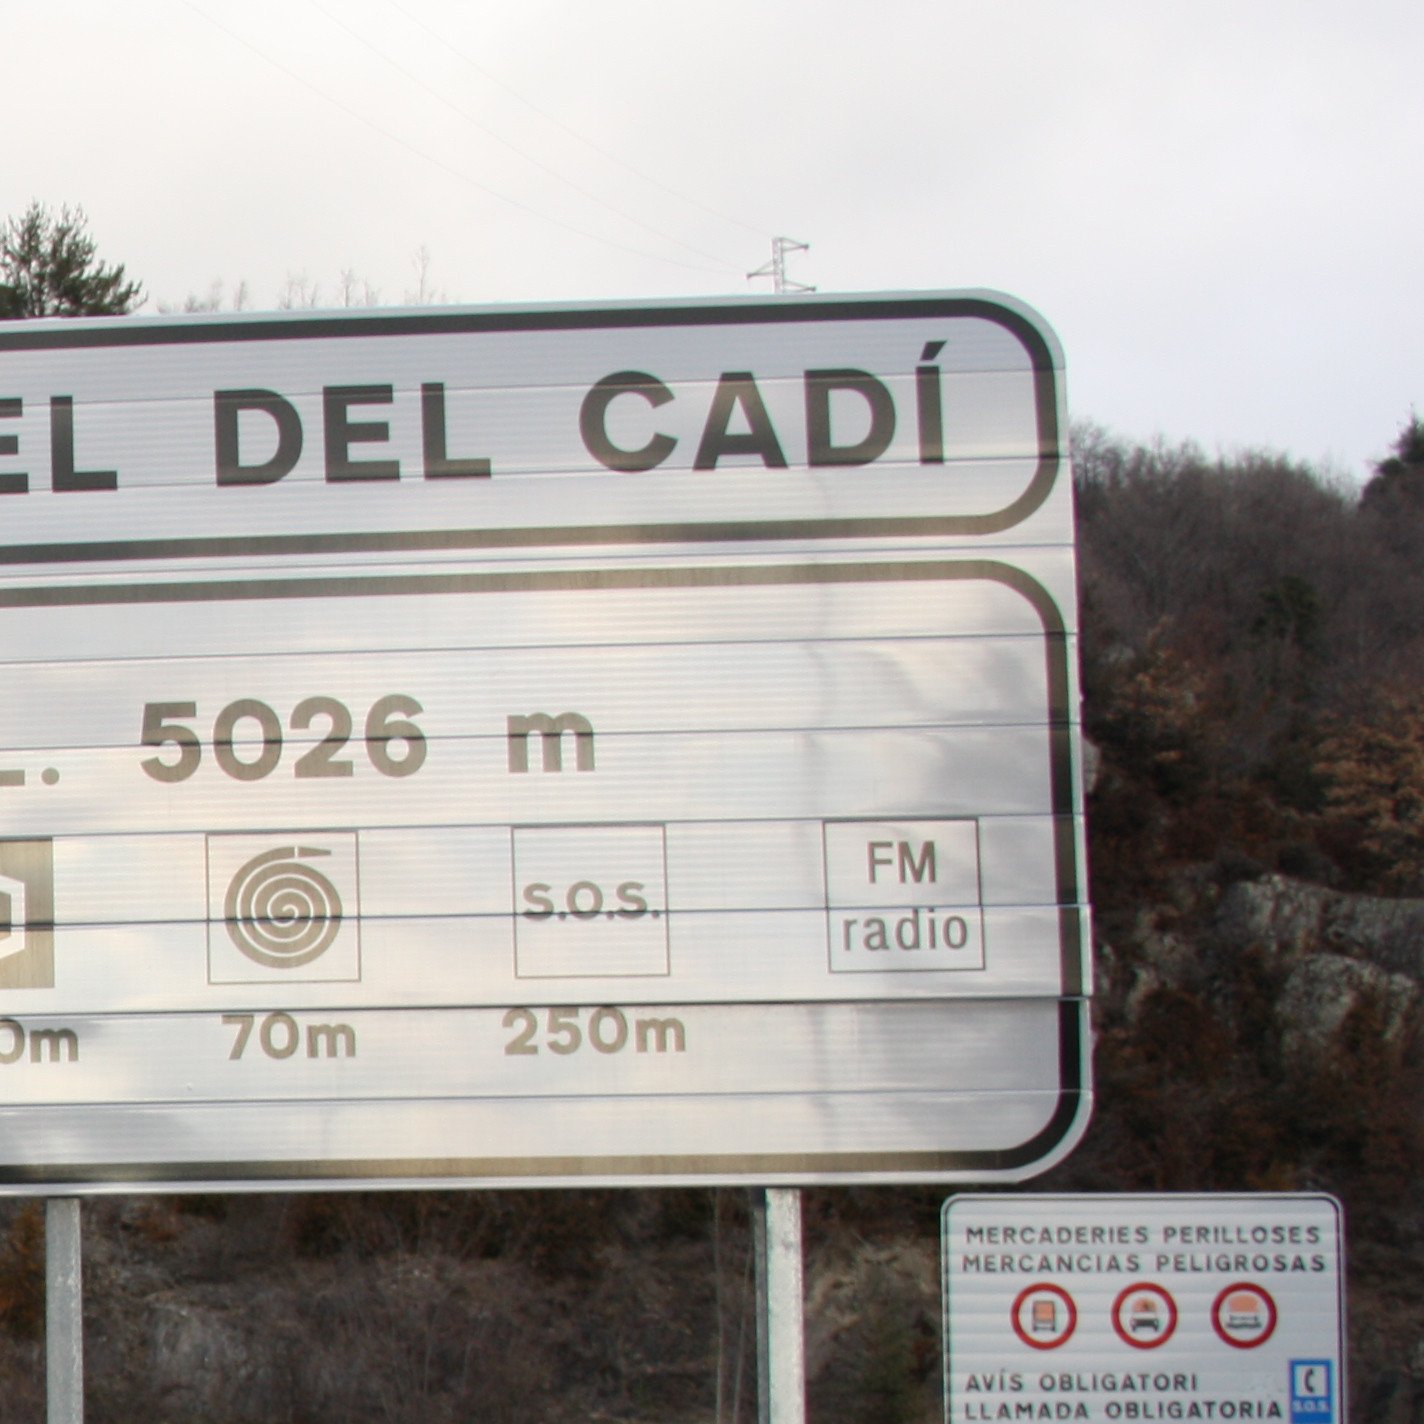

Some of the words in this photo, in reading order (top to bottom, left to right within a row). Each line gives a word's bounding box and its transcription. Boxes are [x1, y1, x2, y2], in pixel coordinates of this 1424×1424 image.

[214, 382, 491, 487] DEL
[579, 340, 947, 474] CADÍ
[139, 695, 429, 783] 5026
[508, 711, 596, 774] m
[866, 841, 937, 886] FM
[843, 904, 968, 952] radio
[223, 1012, 357, 1062] 70m
[502, 1006, 687, 1057] 250m
[965, 1226, 1148, 1245] MERCADERIES
[1163, 1225, 1320, 1244] PERILLOSES
[962, 1255, 1141, 1273] MERCANCIAS
[1156, 1254, 1325, 1272] PELIGROSAS
[965, 1369, 1023, 1392] AVÍS
[1039, 1373, 1197, 1392] OBLIGATORI
[965, 1401, 1089, 1420] LLAMADA
[1105, 1401, 1283, 1419] OBLIGATORIA
